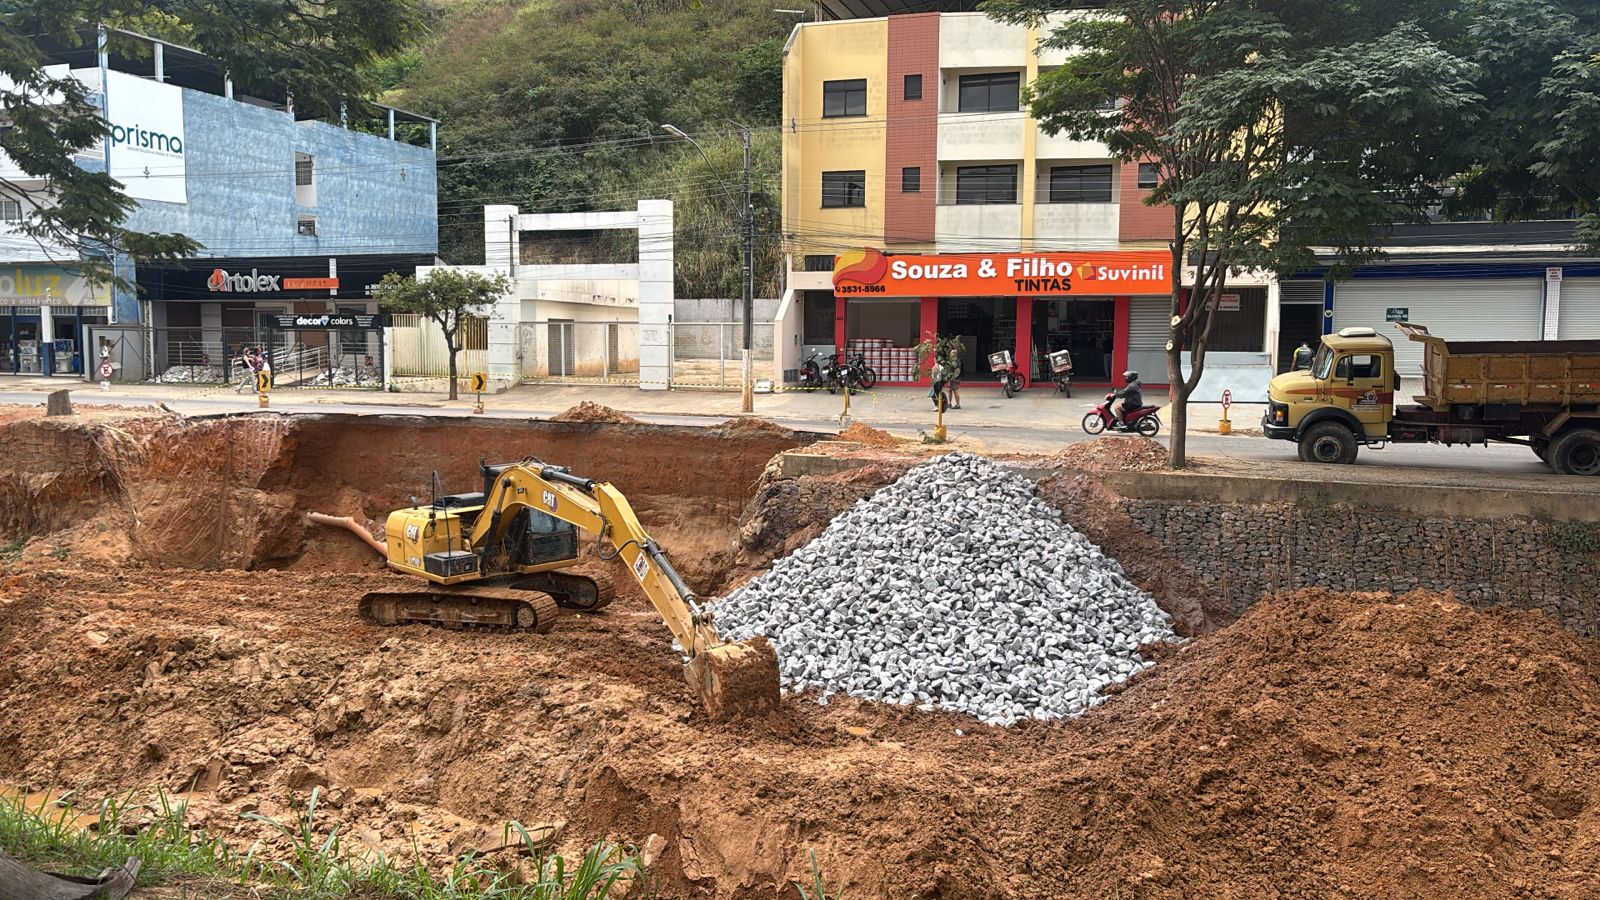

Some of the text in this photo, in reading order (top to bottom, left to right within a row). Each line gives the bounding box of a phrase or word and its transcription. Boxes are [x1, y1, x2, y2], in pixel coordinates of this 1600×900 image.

[112, 124, 183, 154] prisma
[891, 257, 1073, 279] Souza & Filho
[1097, 265, 1164, 281] Suvinil
[207, 268, 280, 293] Artolex
[1014, 278, 1072, 292] TINTAS
[841, 285, 886, 293] 3531-5966
[296, 316, 321, 325] decor
[330, 317, 353, 325] colors
[543, 490, 556, 508] CAT
[406, 524, 419, 540] CAT
